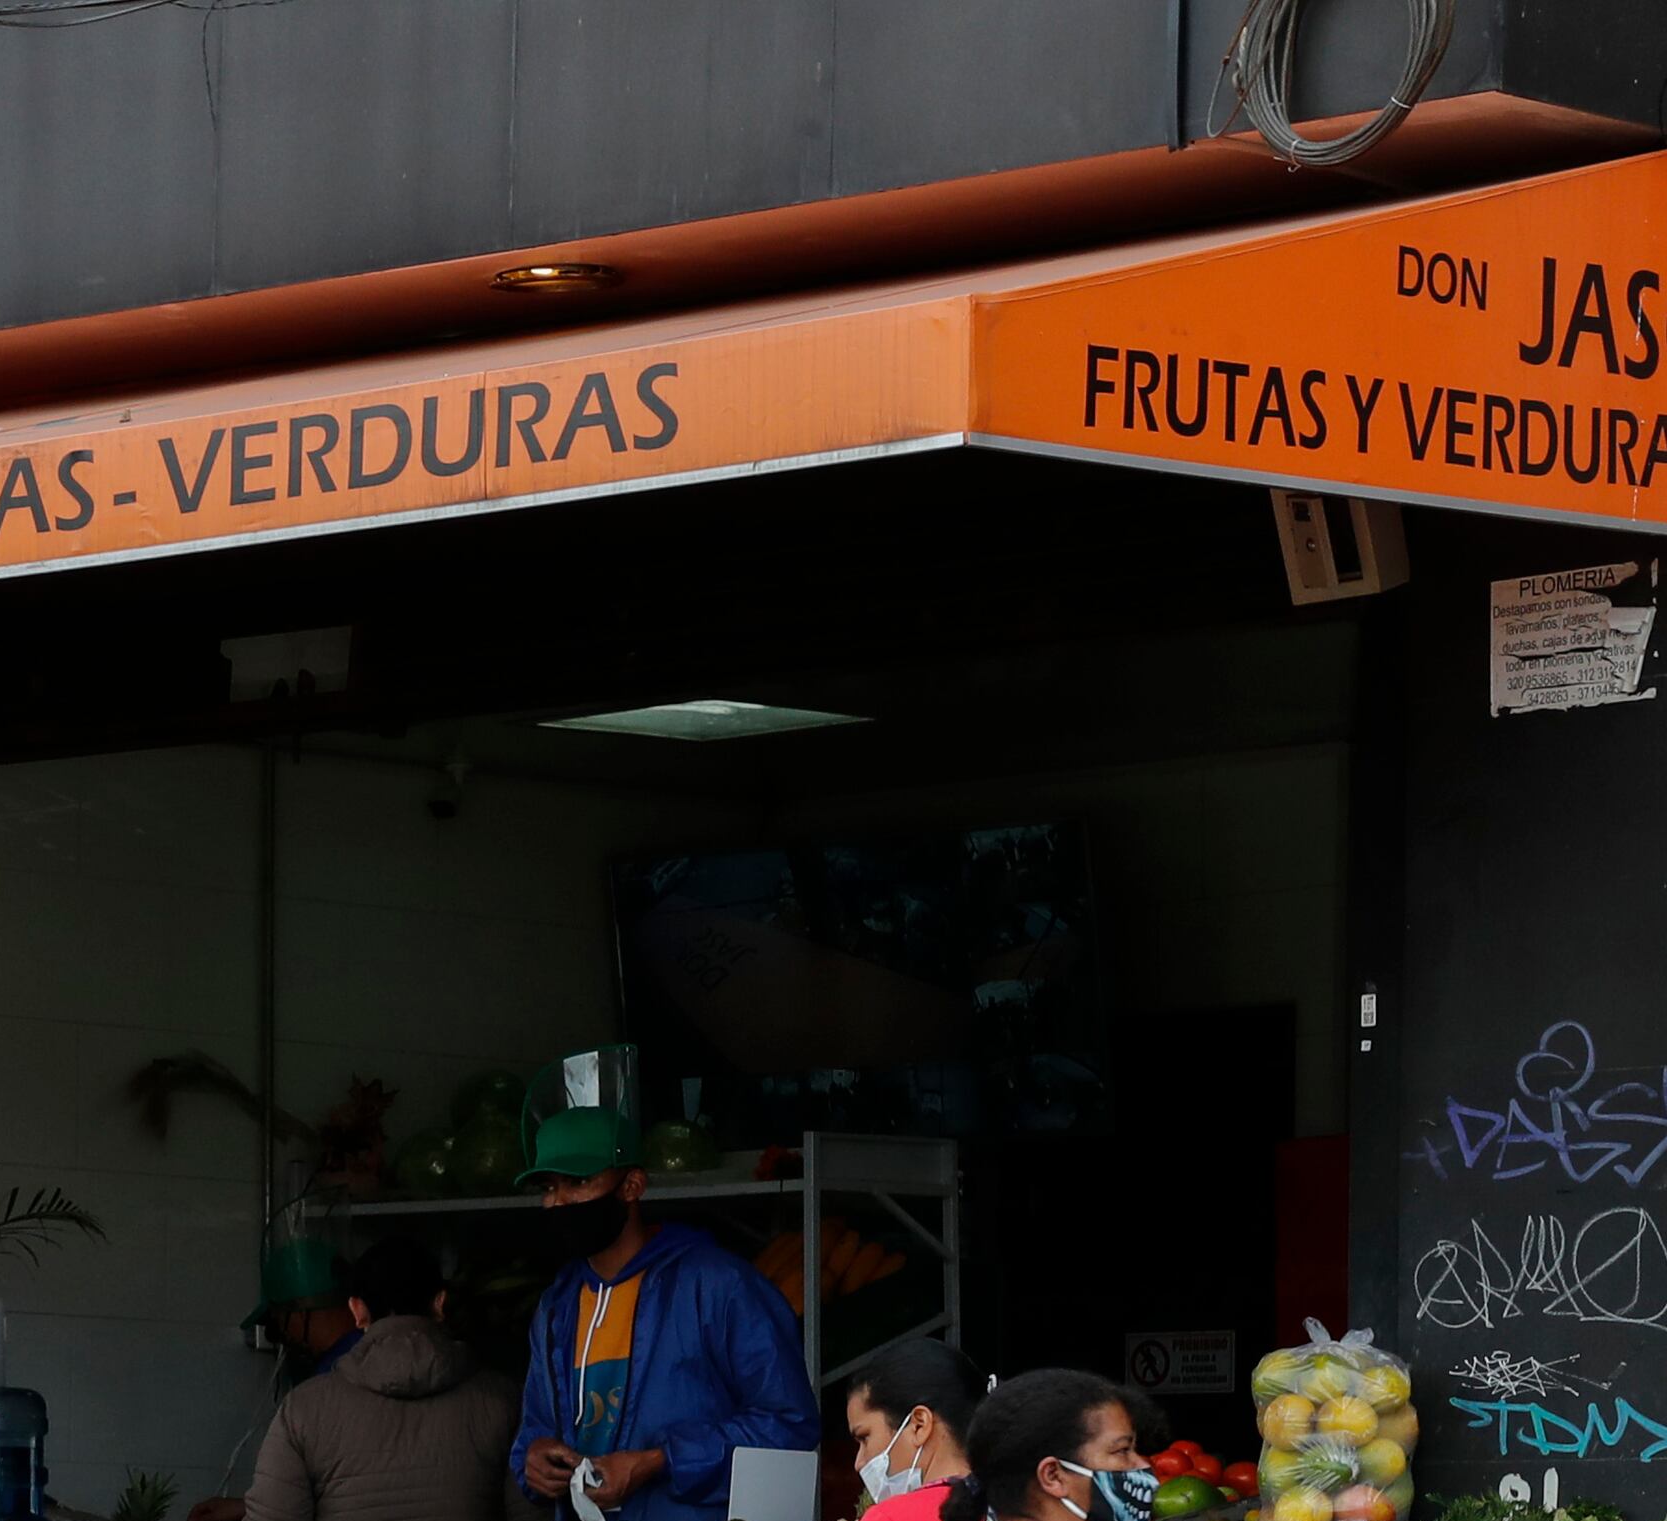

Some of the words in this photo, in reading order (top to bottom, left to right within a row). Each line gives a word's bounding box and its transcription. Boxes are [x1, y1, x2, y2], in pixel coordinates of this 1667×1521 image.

[1397, 245, 1488, 311] DON
[1518, 256, 1667, 380] JAS
[158, 361, 679, 514] VERDURAS
[1084, 344, 1327, 450] FRUTAS
[1346, 374, 1384, 453] Y
[1519, 567, 1616, 598] PLOMERIA
[1542, 634, 1568, 650] cajas
[1570, 633, 1584, 645] de
